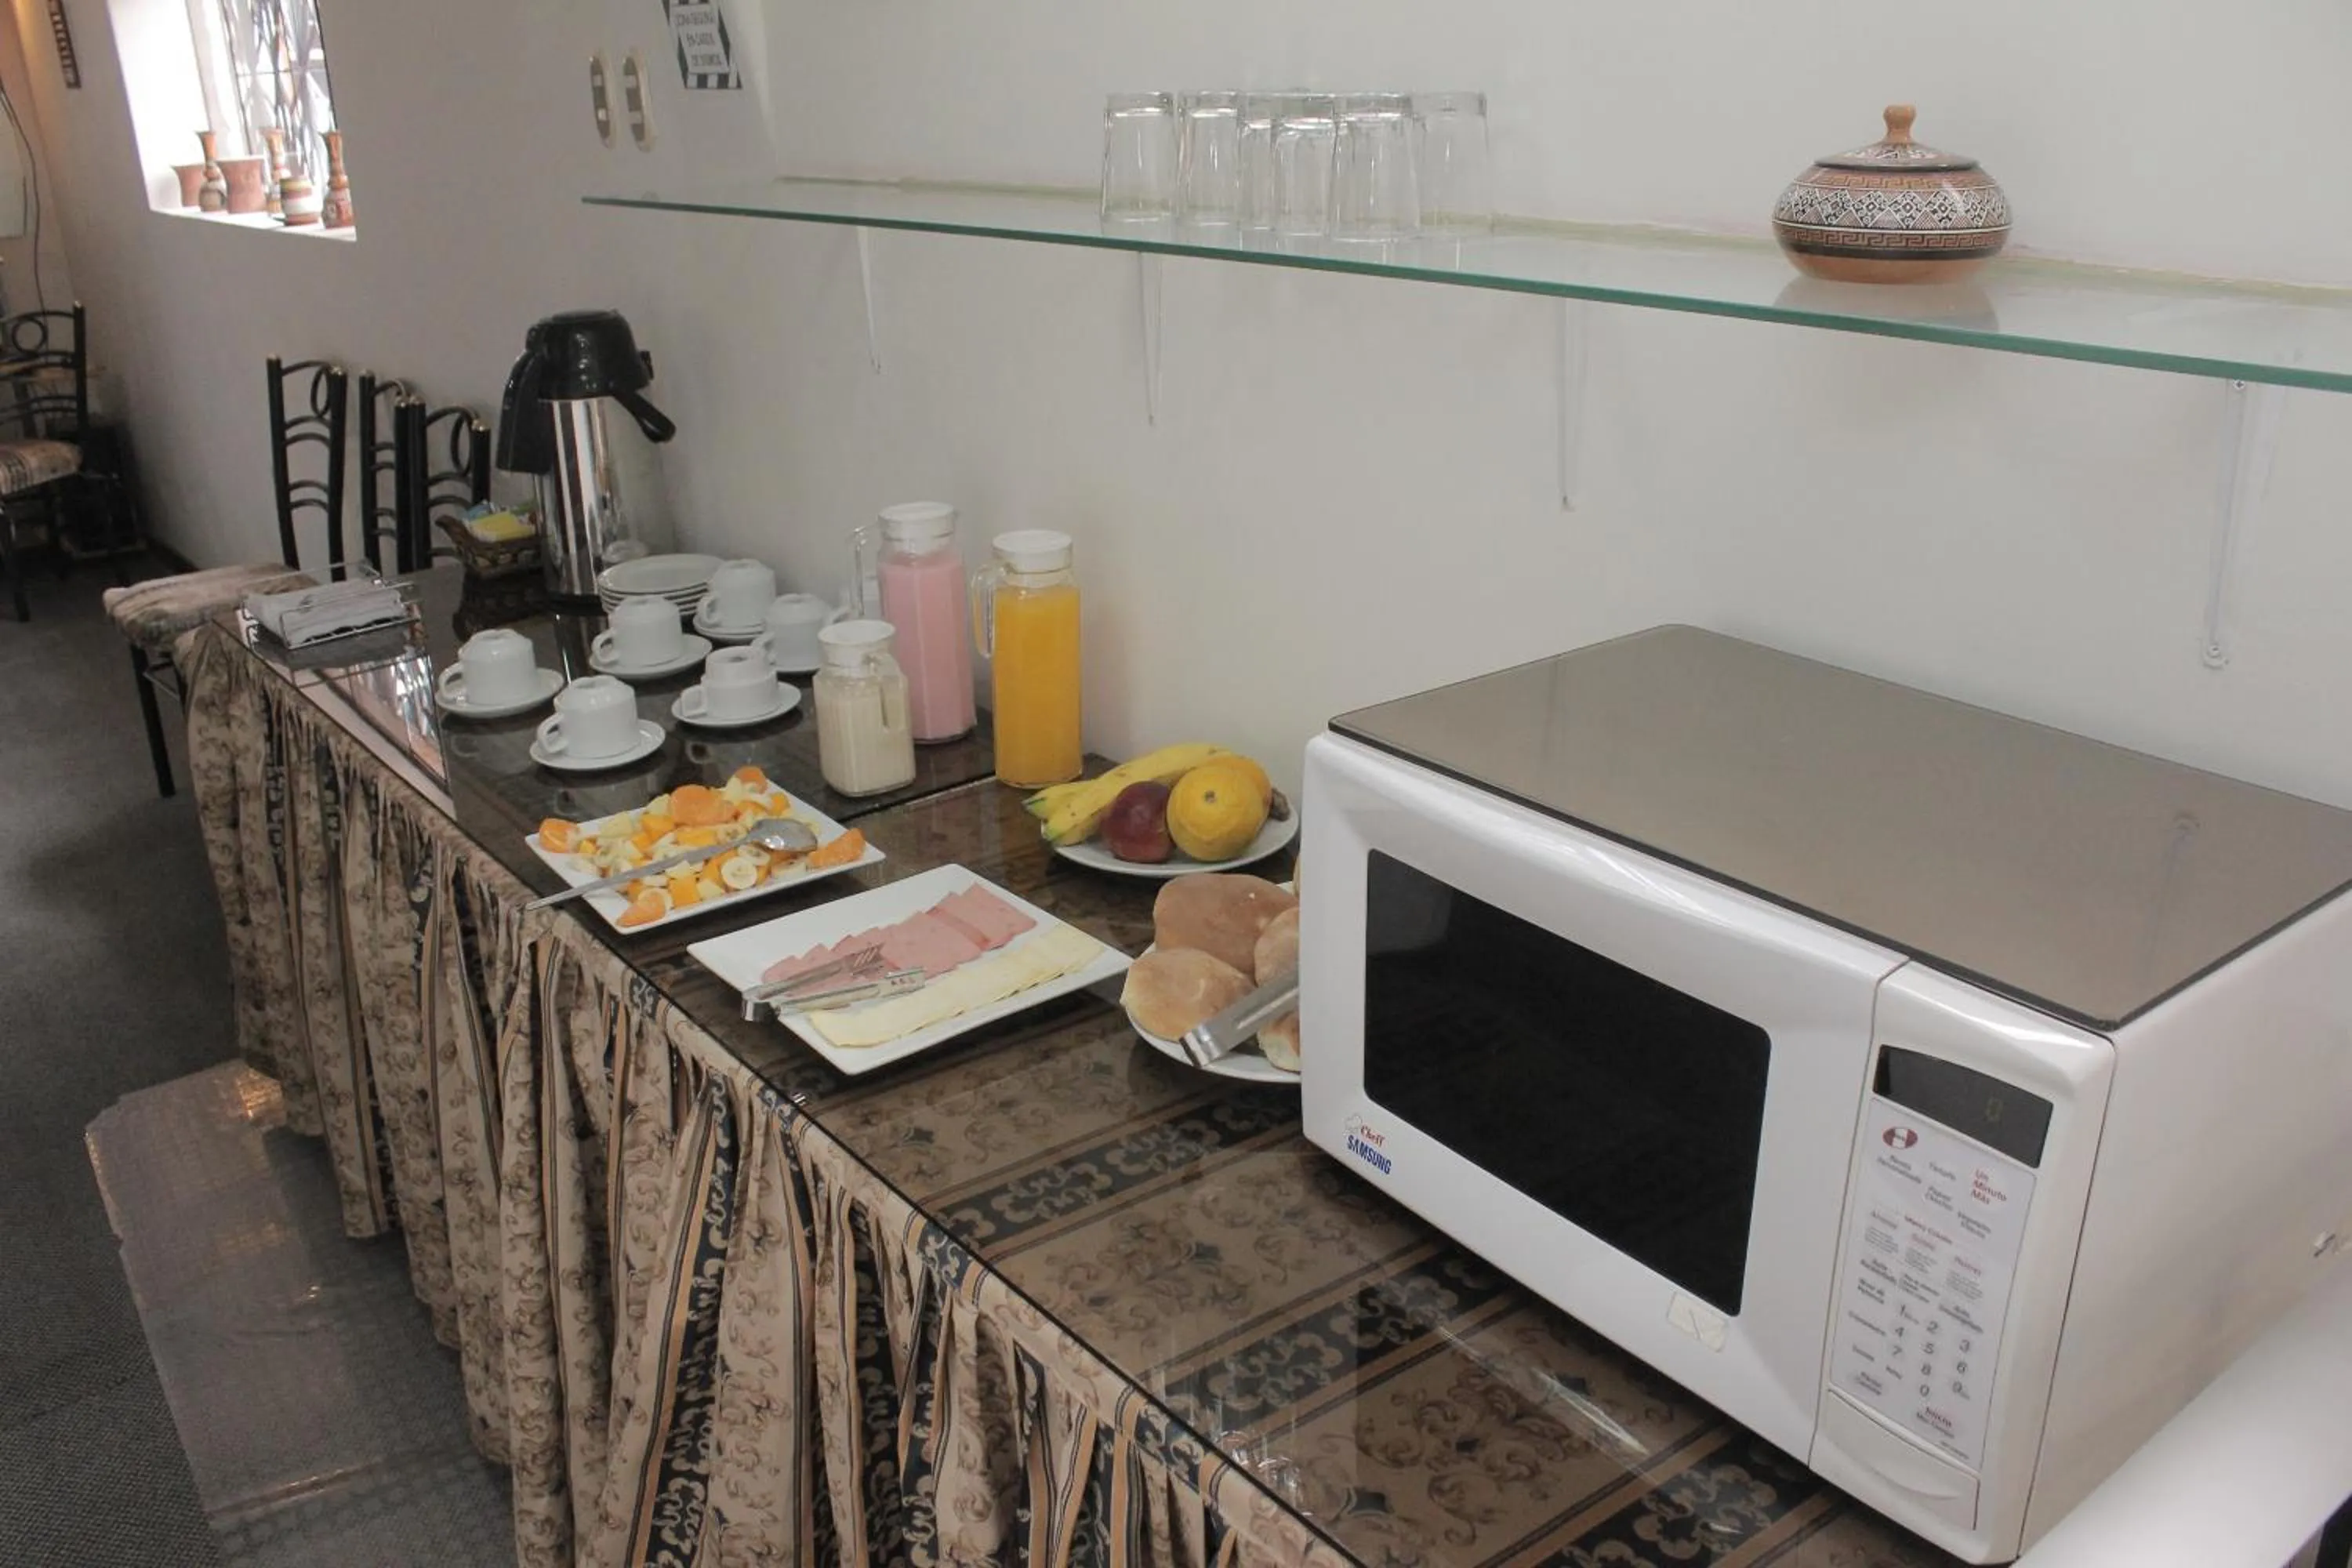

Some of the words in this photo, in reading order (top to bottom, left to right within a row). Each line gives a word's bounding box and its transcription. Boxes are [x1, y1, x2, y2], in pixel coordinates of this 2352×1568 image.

[1348, 1134, 1392, 1174] SAMSUNG
[1973, 1180, 2007, 1202] Minuto
[1895, 1327, 1905, 1338] 4
[1923, 1342, 1934, 1355] 5
[1927, 1320, 1939, 1334] 2
[1959, 1339, 1970, 1353] 3
[1892, 1345, 1903, 1356] 7
[1921, 1363, 1932, 1376] 8
[1919, 1384, 1930, 1398] 0
